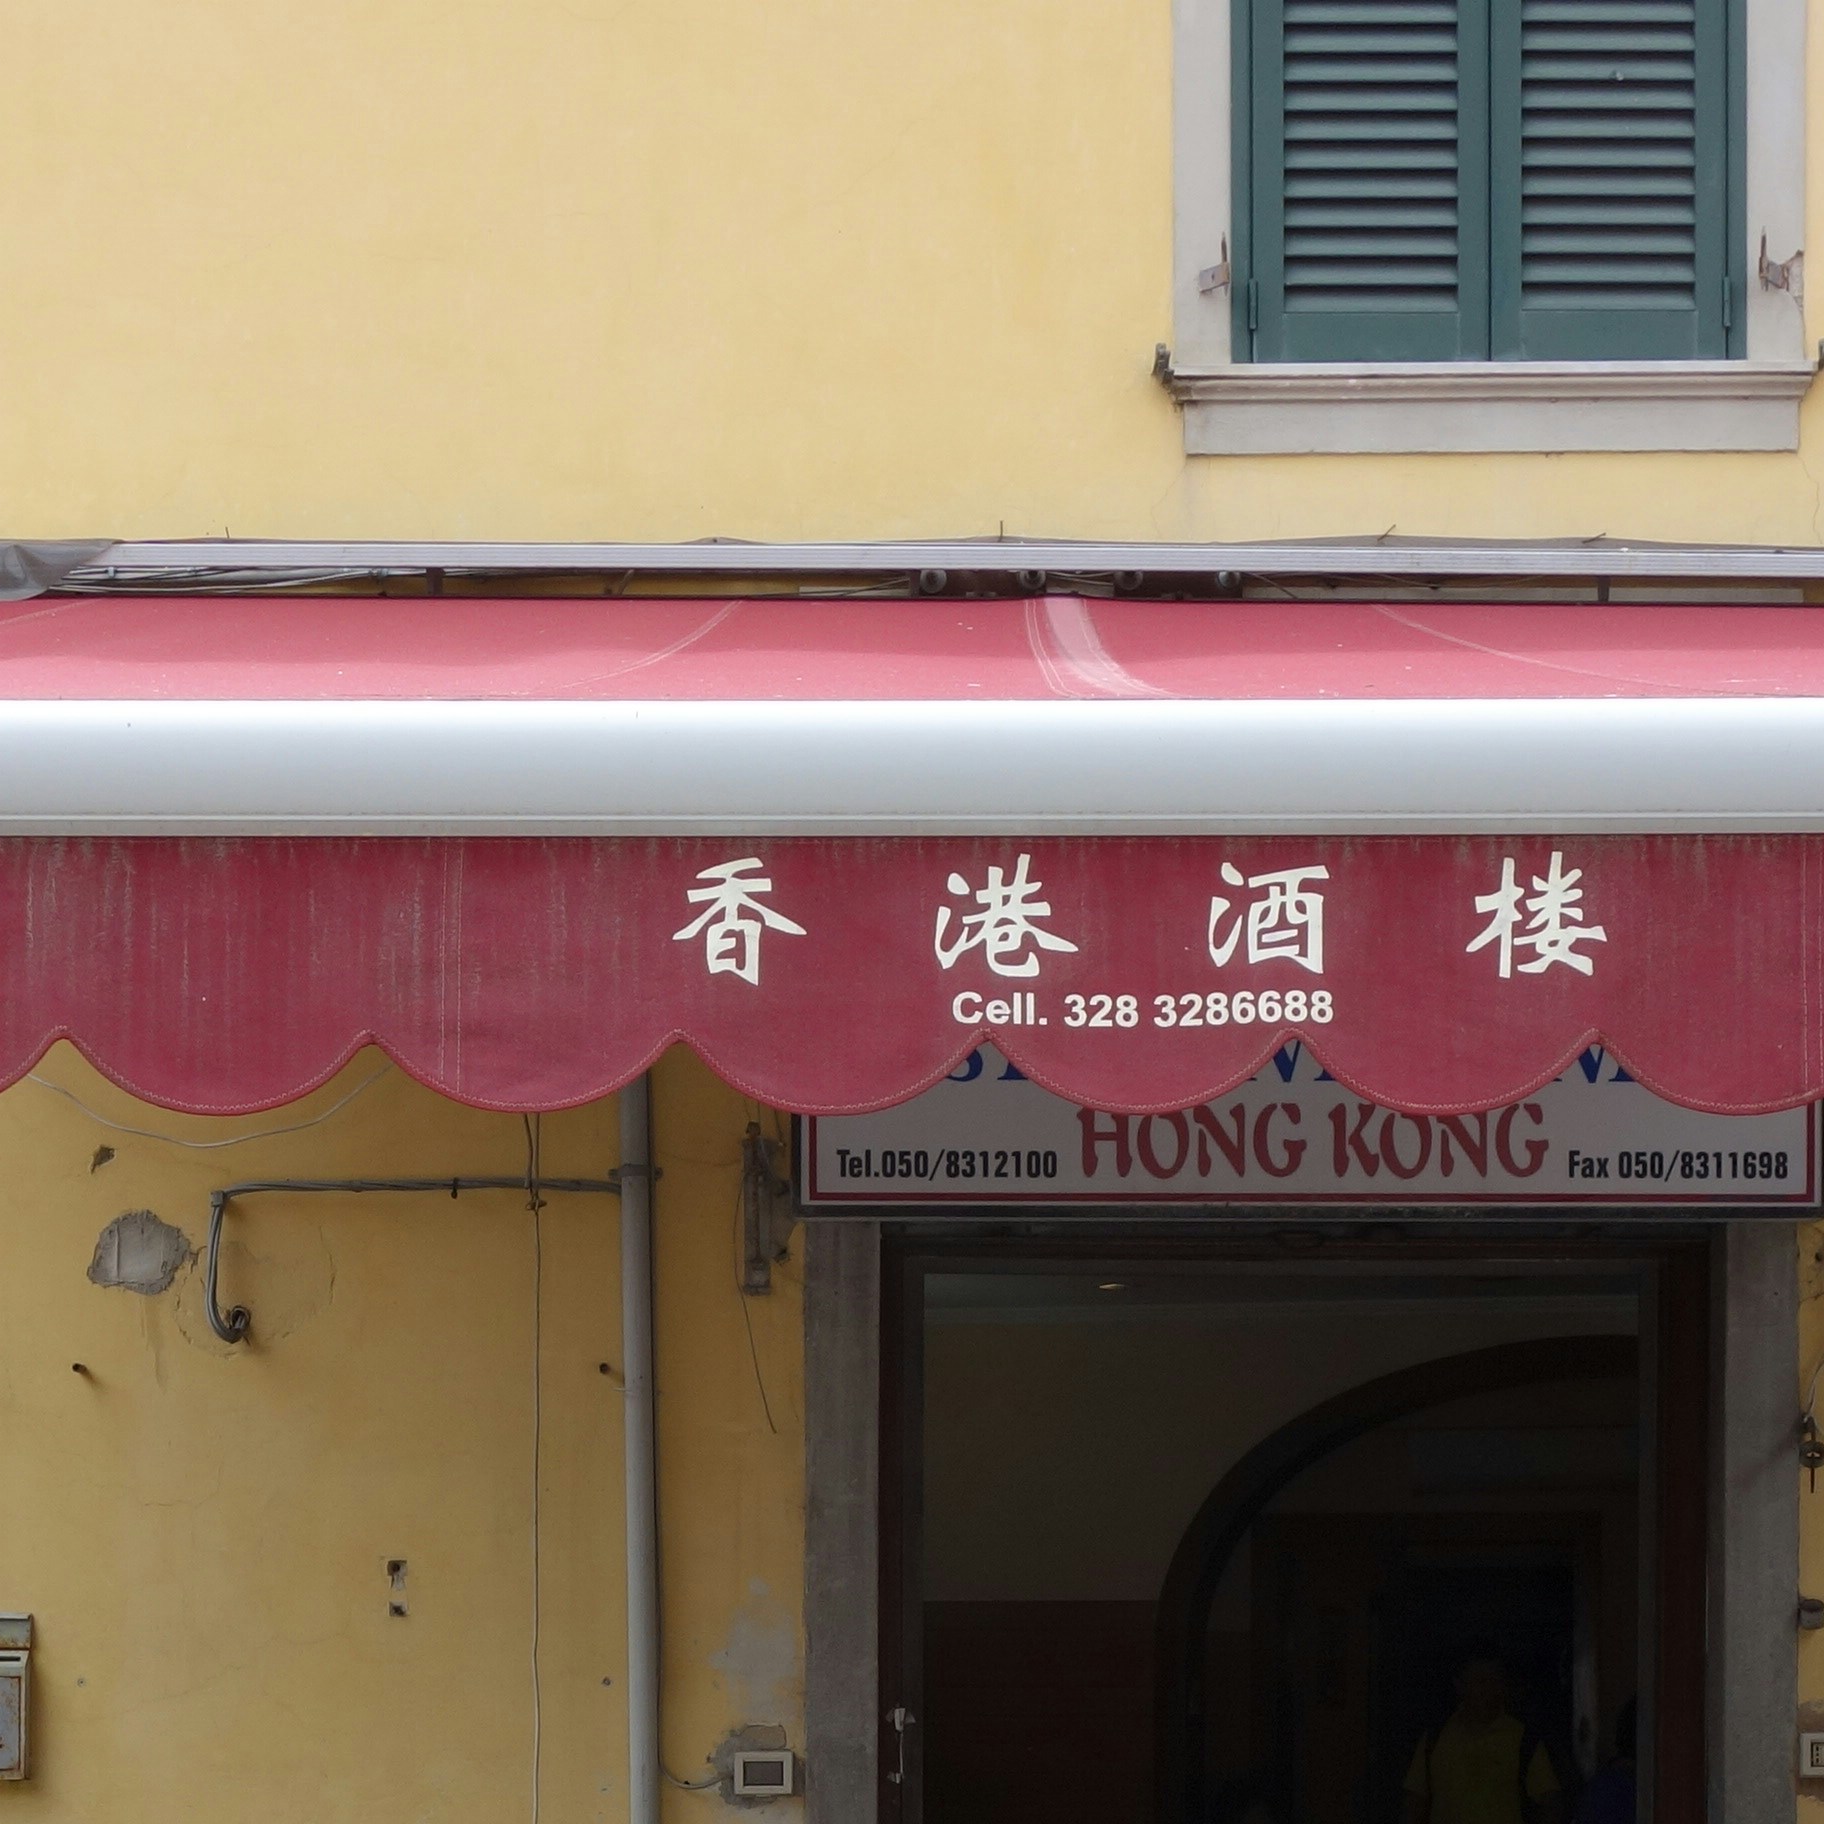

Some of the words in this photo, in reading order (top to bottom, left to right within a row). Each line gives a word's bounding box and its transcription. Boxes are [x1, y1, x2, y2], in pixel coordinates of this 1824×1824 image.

[672, 851, 1608, 986] 香港酒楼
[952, 991, 1048, 1026] Cell.
[1063, 993, 1139, 1028] 328
[1153, 989, 1334, 1028] 3286688
[1076, 1102, 1305, 1180] HONG
[1330, 1102, 1549, 1180] KONG
[836, 1148, 1057, 1182] Tel.050/8312100
[1567, 1149, 1609, 1180] Fax
[1617, 1150, 1789, 1183] 050/8311698
